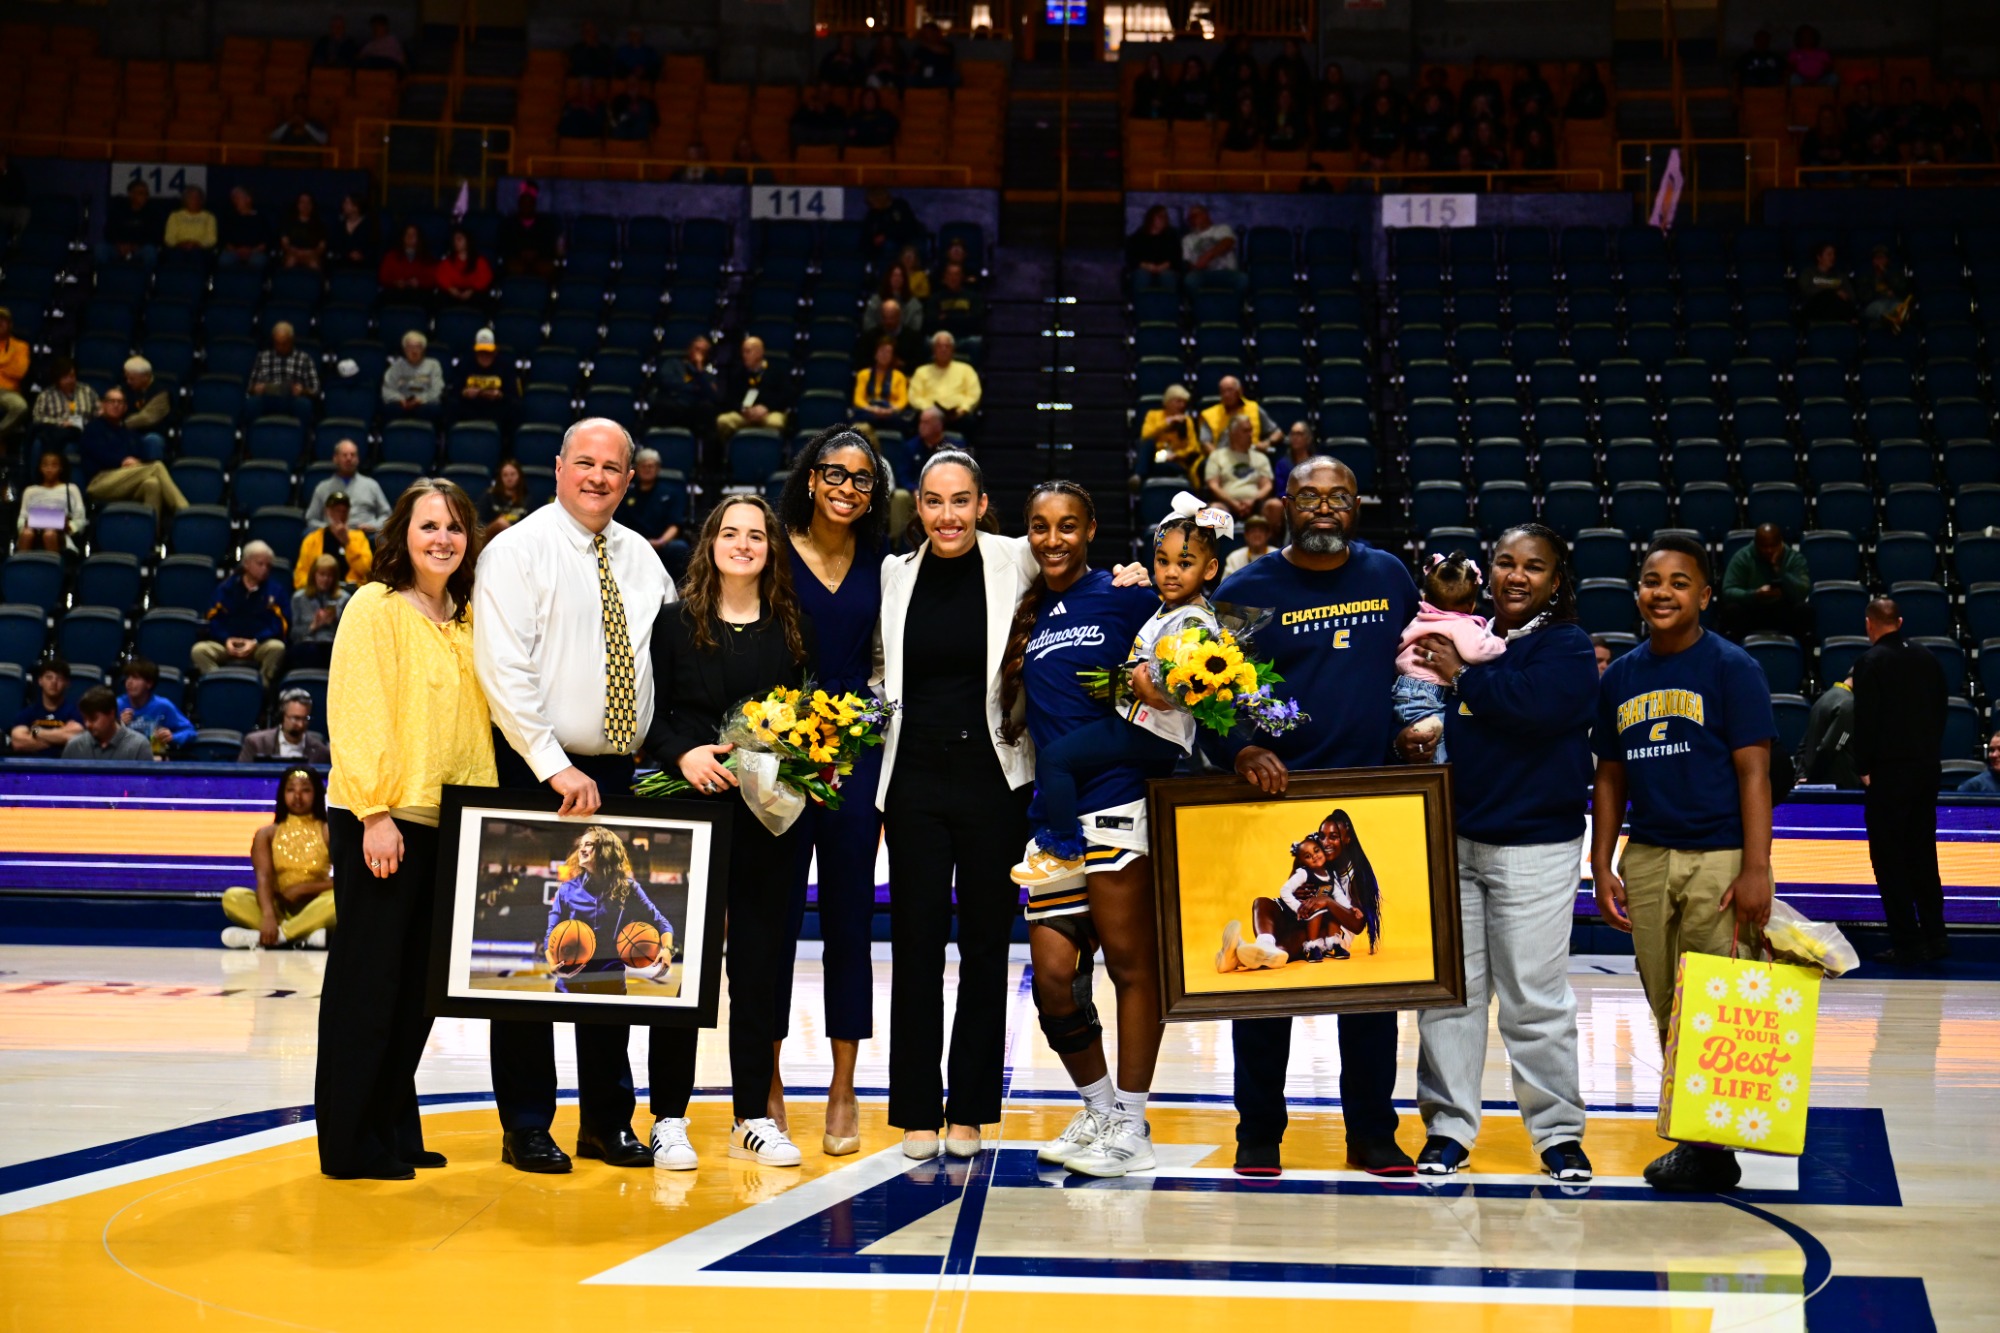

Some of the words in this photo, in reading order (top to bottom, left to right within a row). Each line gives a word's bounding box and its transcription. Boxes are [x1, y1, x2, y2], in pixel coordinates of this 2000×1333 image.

[130, 167, 186, 193] 114
[769, 189, 826, 216] 114
[1400, 197, 1457, 223] 115
[1281, 598, 1390, 626] CHATTANOOGA
[1293, 613, 1385, 635] BASKETBALL
[1025, 625, 1106, 656] attanooga
[1332, 629, 1351, 649] C
[1616, 688, 1705, 735] CHATTANOOGA
[1648, 721, 1669, 742] C
[1626, 741, 1691, 761] BASKETBALL
[1717, 1005, 1780, 1030] LIVE
[1734, 1028, 1781, 1045] YOUR
[1698, 1035, 1792, 1078] Best
[1712, 1077, 1773, 1103] LIFE
